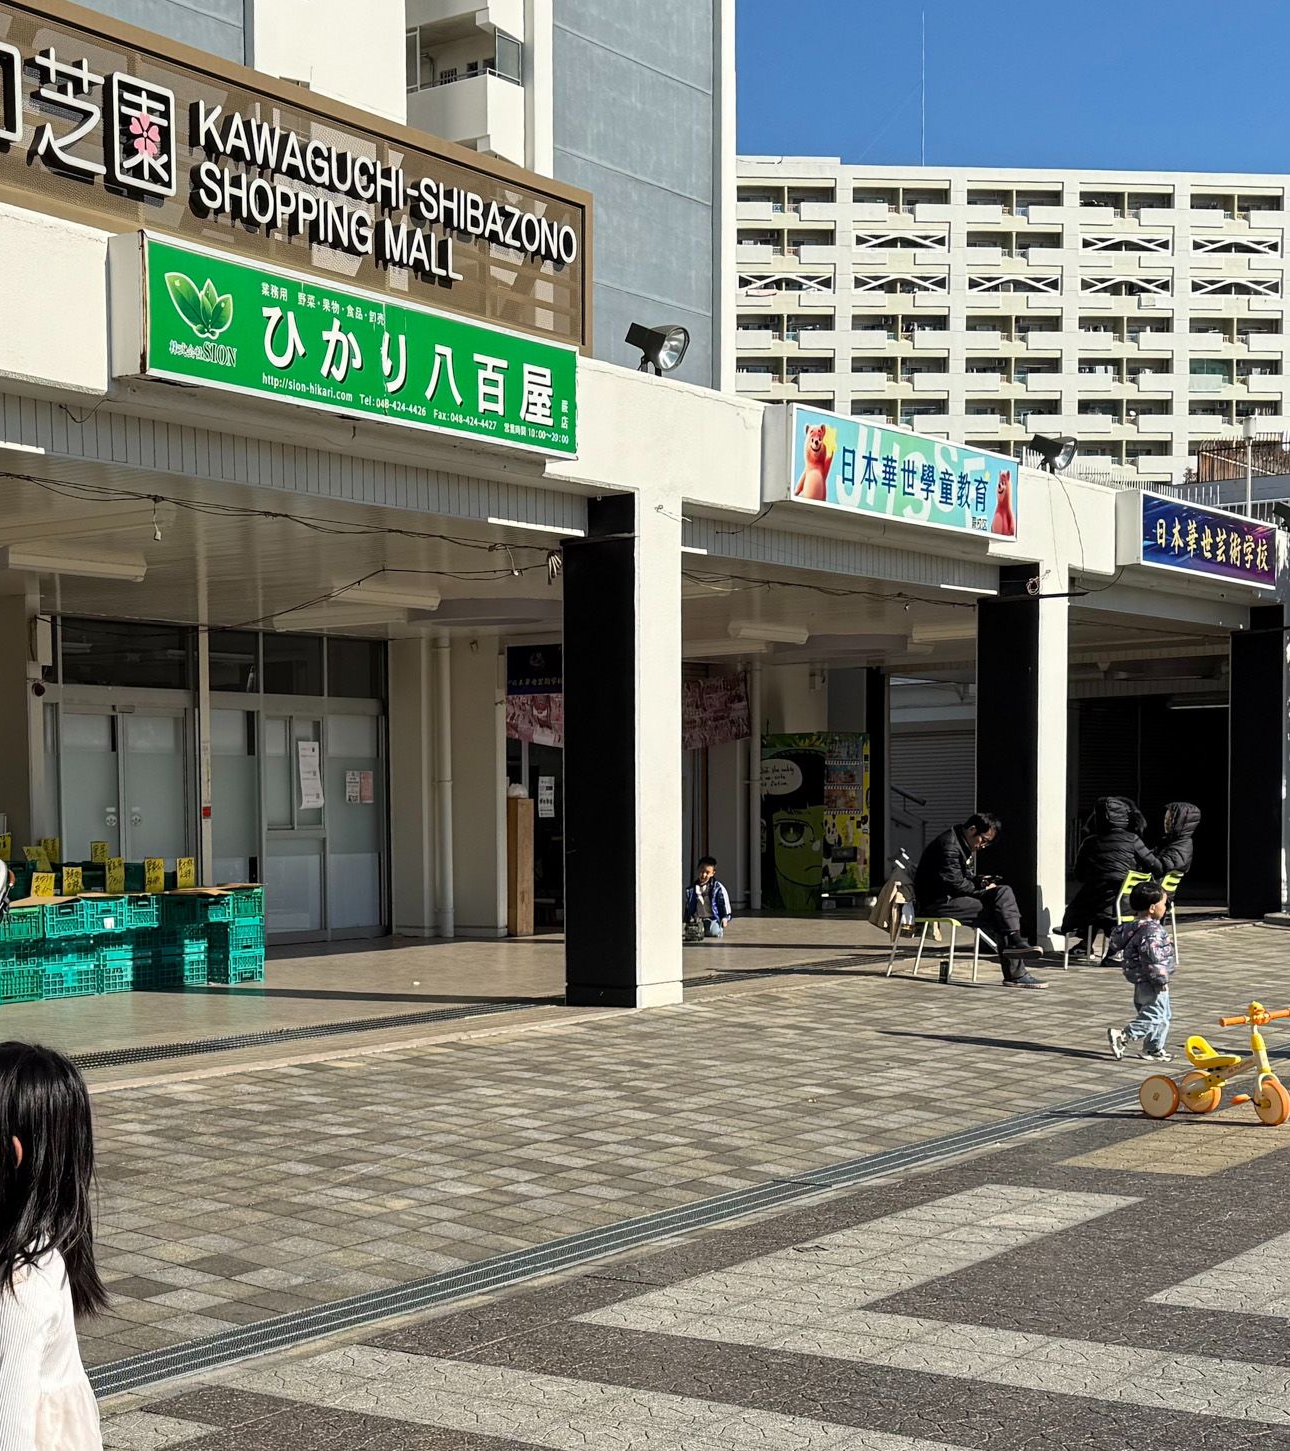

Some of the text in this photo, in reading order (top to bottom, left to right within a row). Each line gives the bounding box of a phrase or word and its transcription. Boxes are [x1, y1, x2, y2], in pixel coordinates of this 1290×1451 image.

[198, 99, 578, 265] KAWAGUCHI-SHIBAZONO
[198, 160, 465, 282] SHOPPING MALL
[261, 305, 556, 428] ひかり八百屋
[262, 372, 353, 402] http://sion-hikari.com
[841, 446, 989, 513] 日本華世學童教育
[1156, 516, 1269, 572] 日本華世芸術学校
